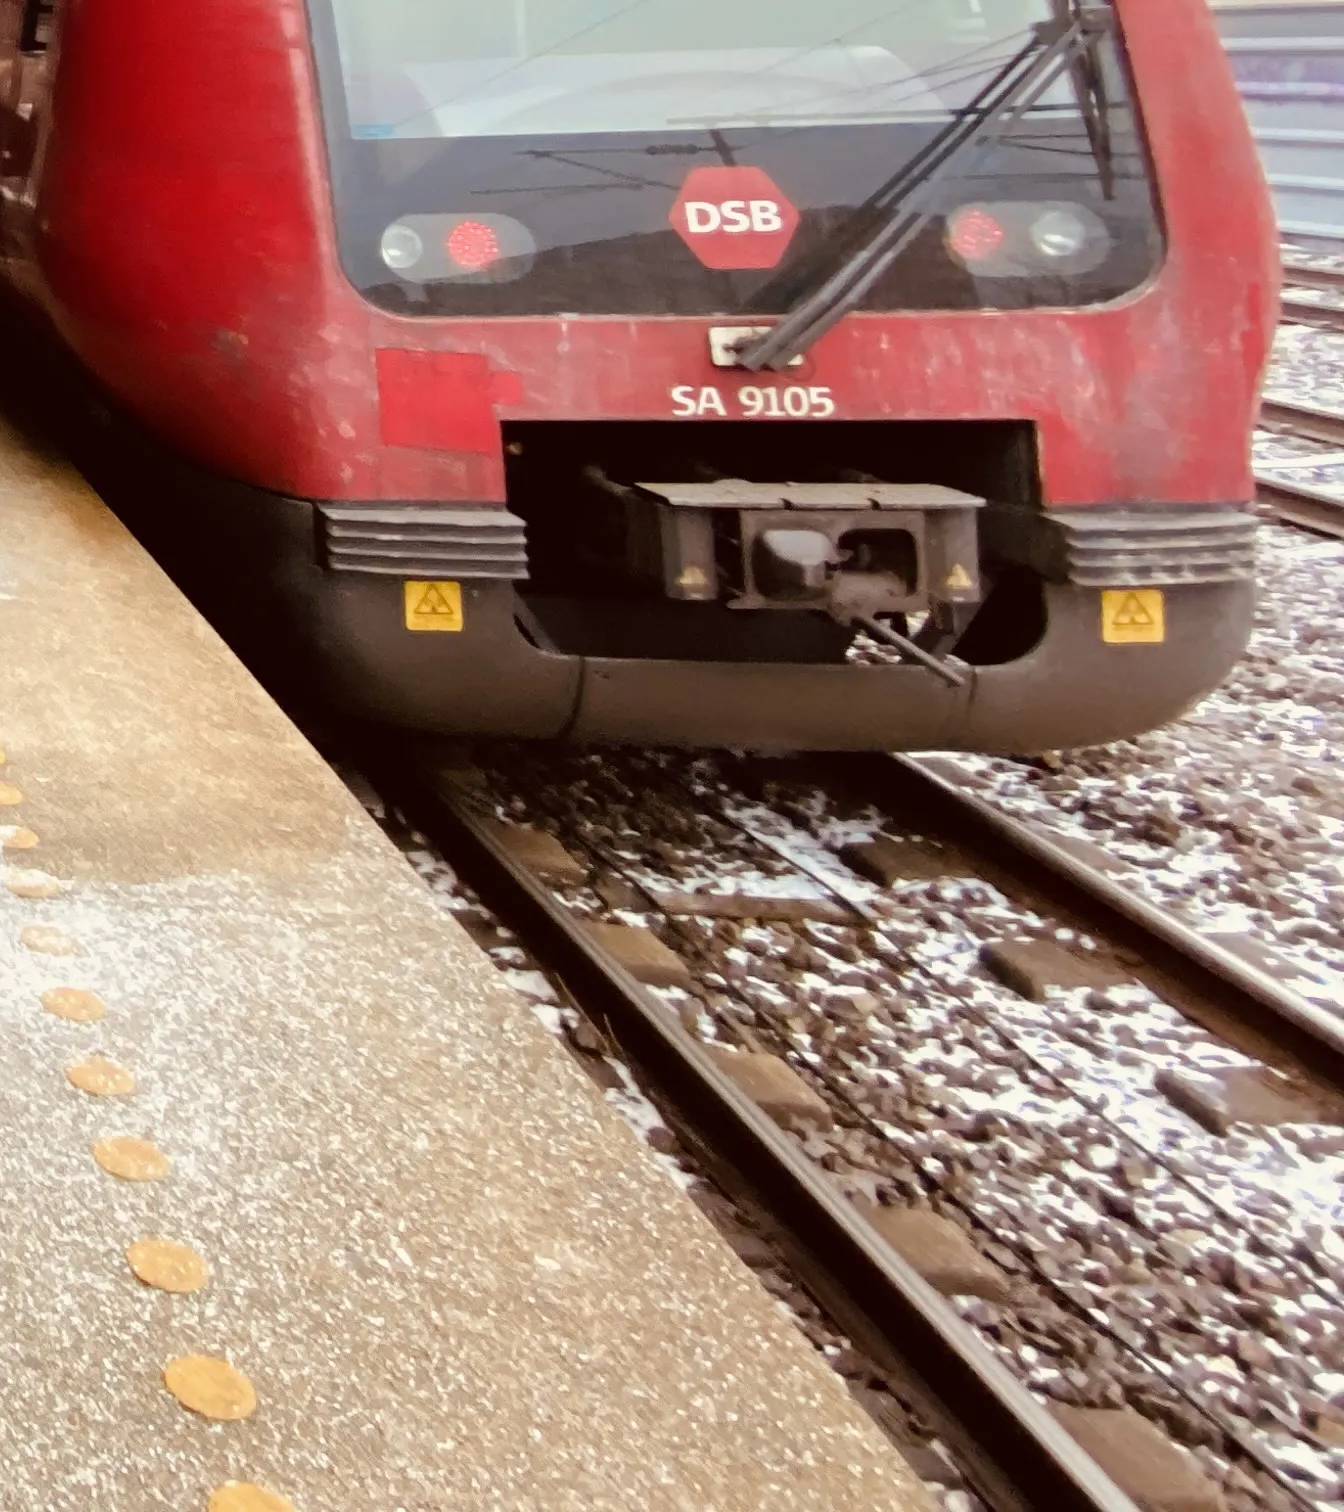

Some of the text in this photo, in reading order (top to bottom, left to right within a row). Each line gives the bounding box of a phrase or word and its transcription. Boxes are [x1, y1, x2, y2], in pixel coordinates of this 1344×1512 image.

[685, 200, 782, 233] DSB
[671, 386, 835, 417] SA 9105
